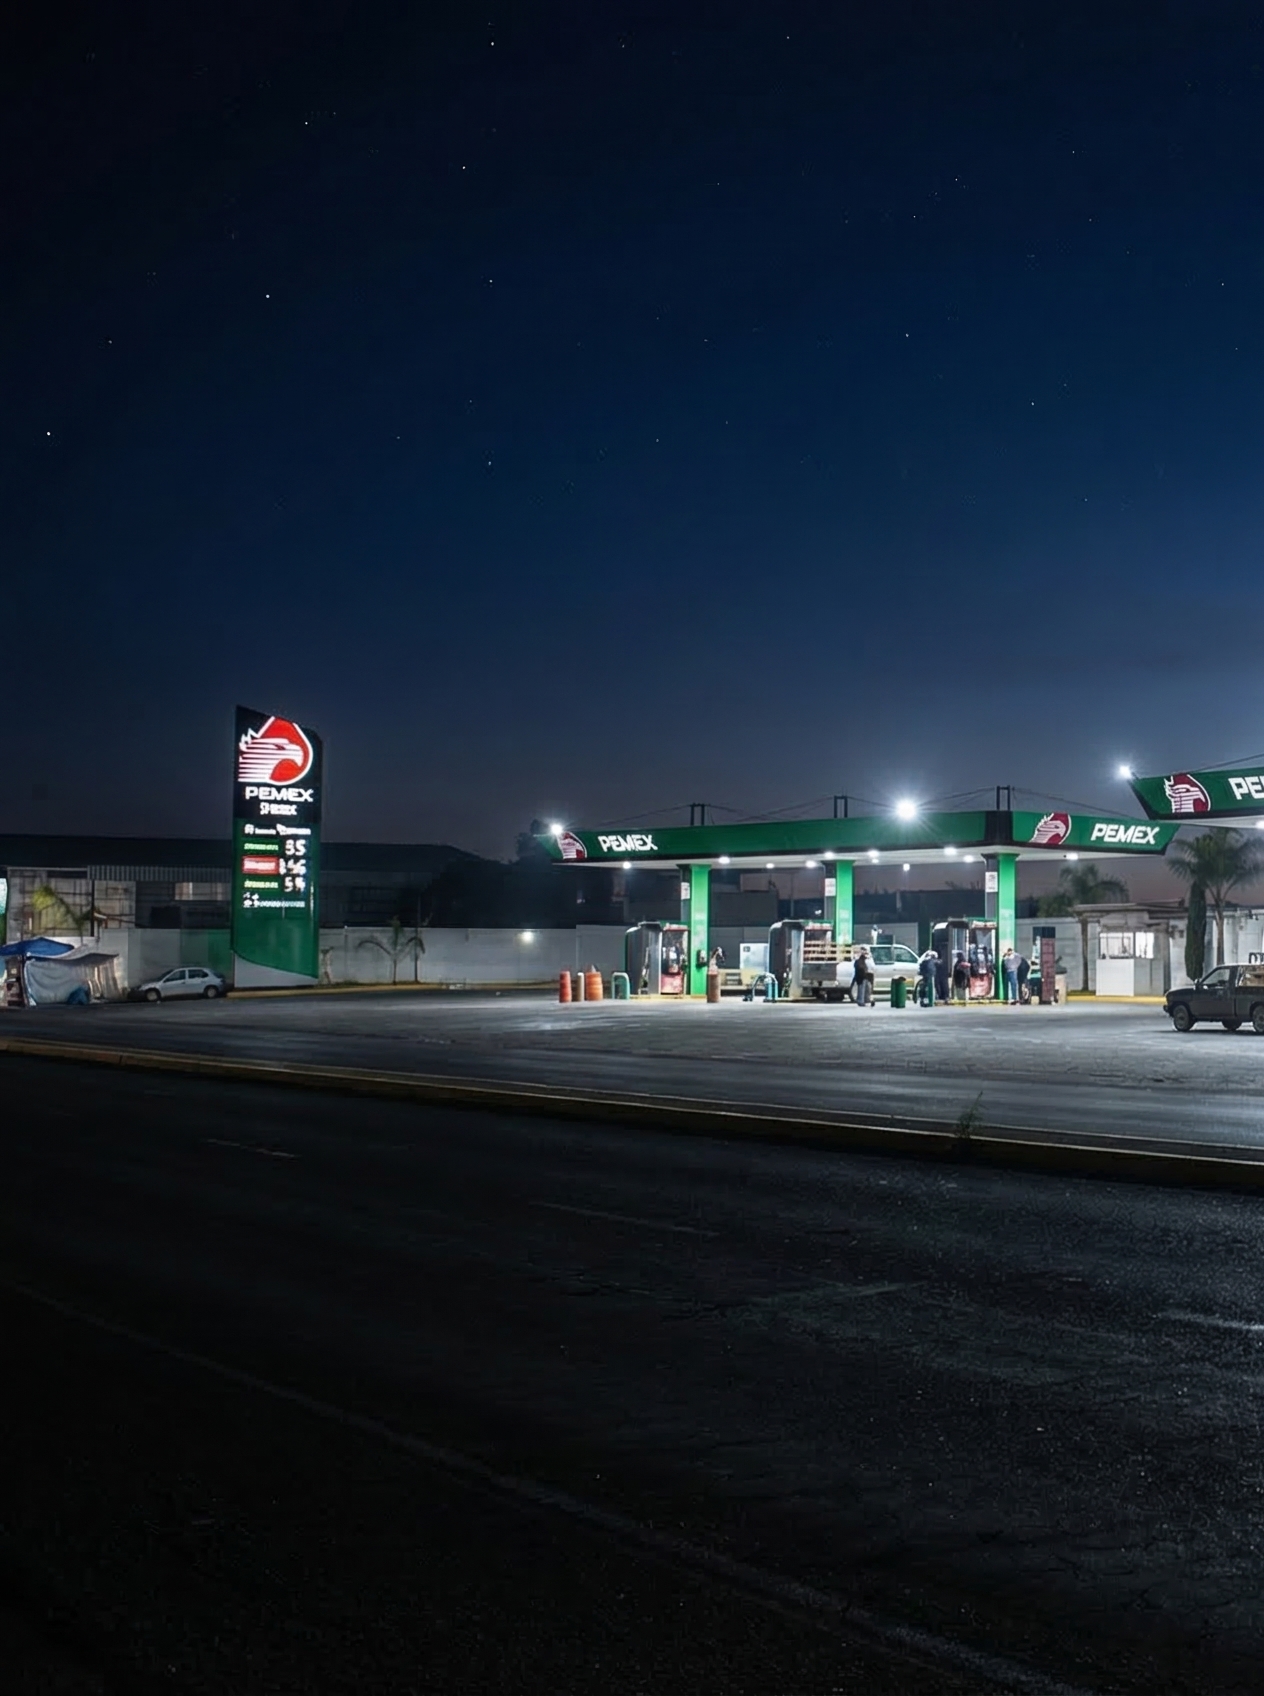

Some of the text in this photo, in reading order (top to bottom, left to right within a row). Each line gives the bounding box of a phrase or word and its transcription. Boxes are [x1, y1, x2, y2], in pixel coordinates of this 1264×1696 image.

[245, 786, 313, 803] PEMEX
[597, 834, 658, 852] PEMEX
[1090, 823, 1160, 845] PEMEX
